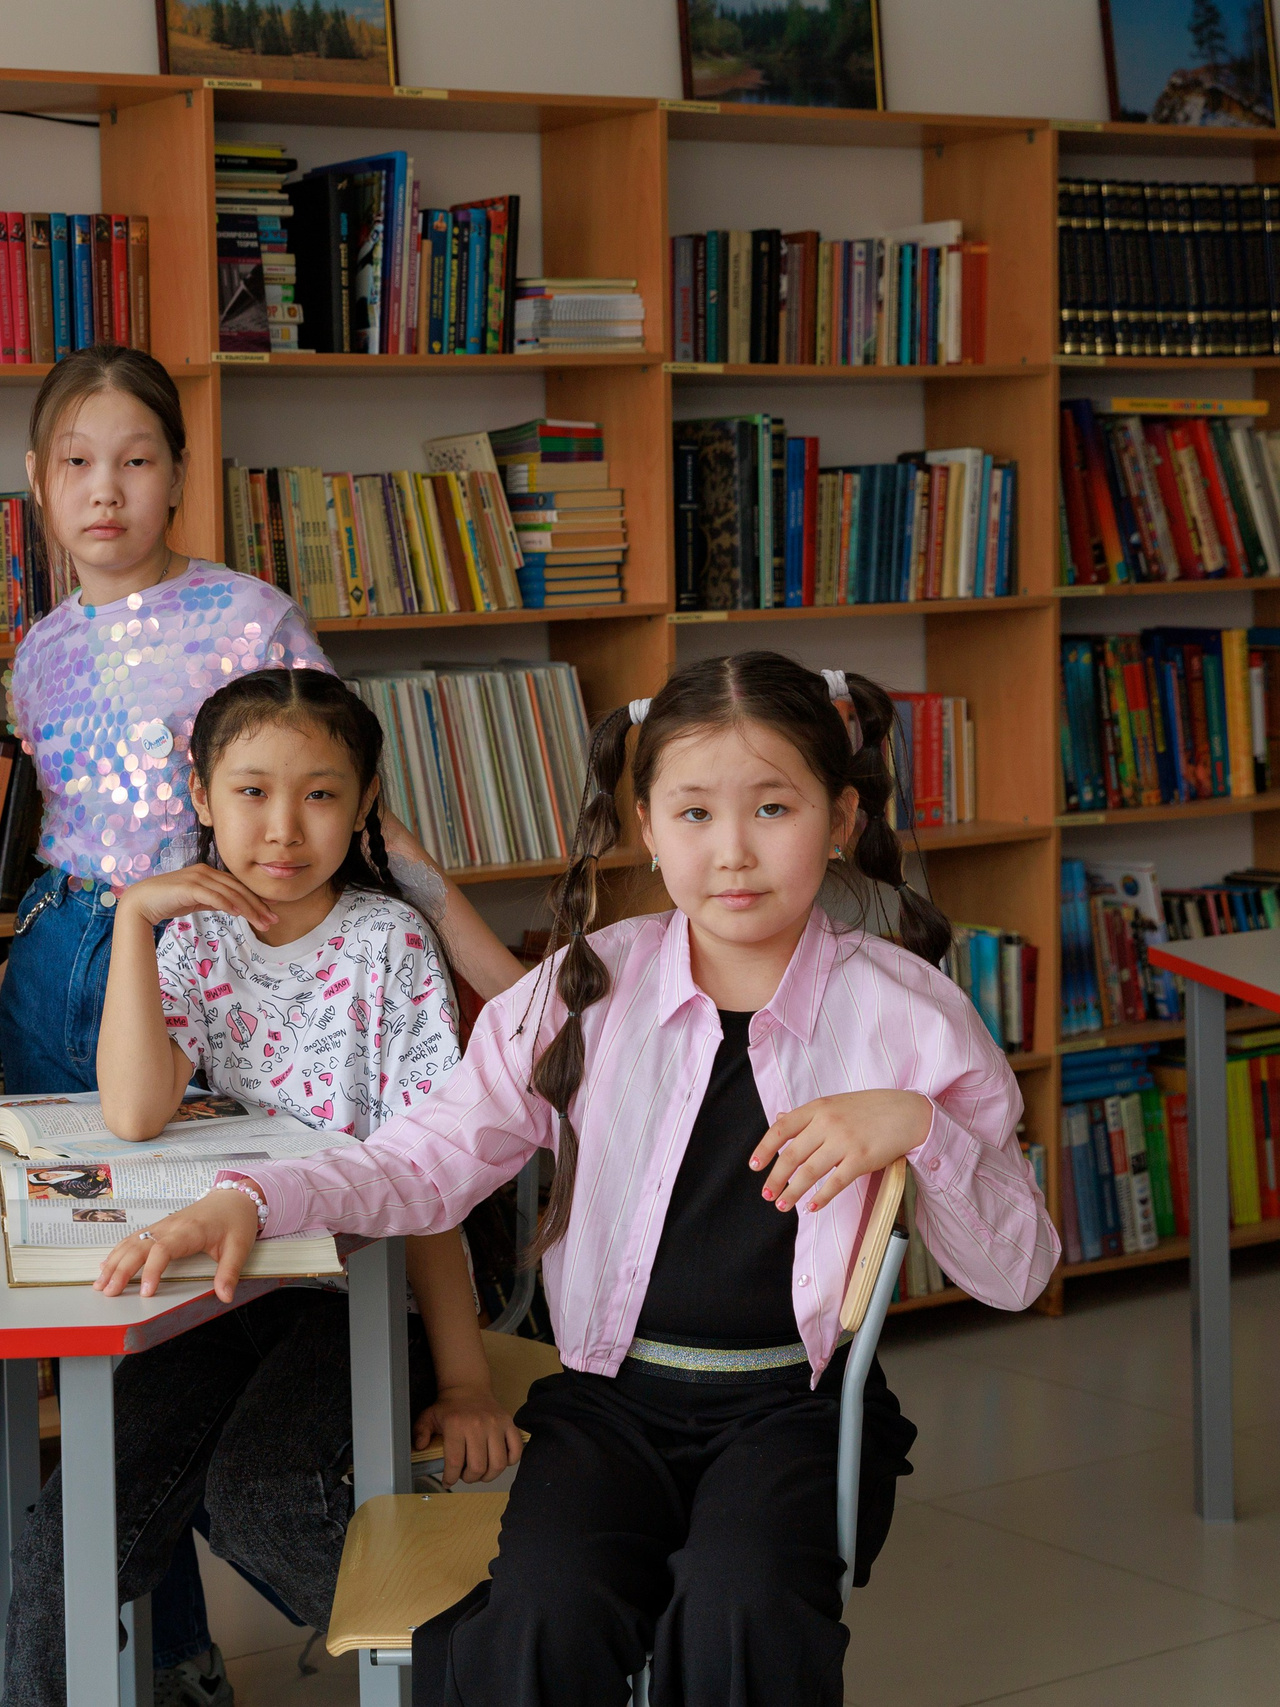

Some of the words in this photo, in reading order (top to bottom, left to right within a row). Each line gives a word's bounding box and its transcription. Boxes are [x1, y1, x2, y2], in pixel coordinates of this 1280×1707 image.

[371, 920, 386, 932] LOVE
[407, 936, 421, 947] LOVE
[314, 1014, 333, 1030] LOVE
[408, 1019, 426, 1037] LOVE
[330, 1029, 347, 1039] Need
[423, 1032, 442, 1046] Need
